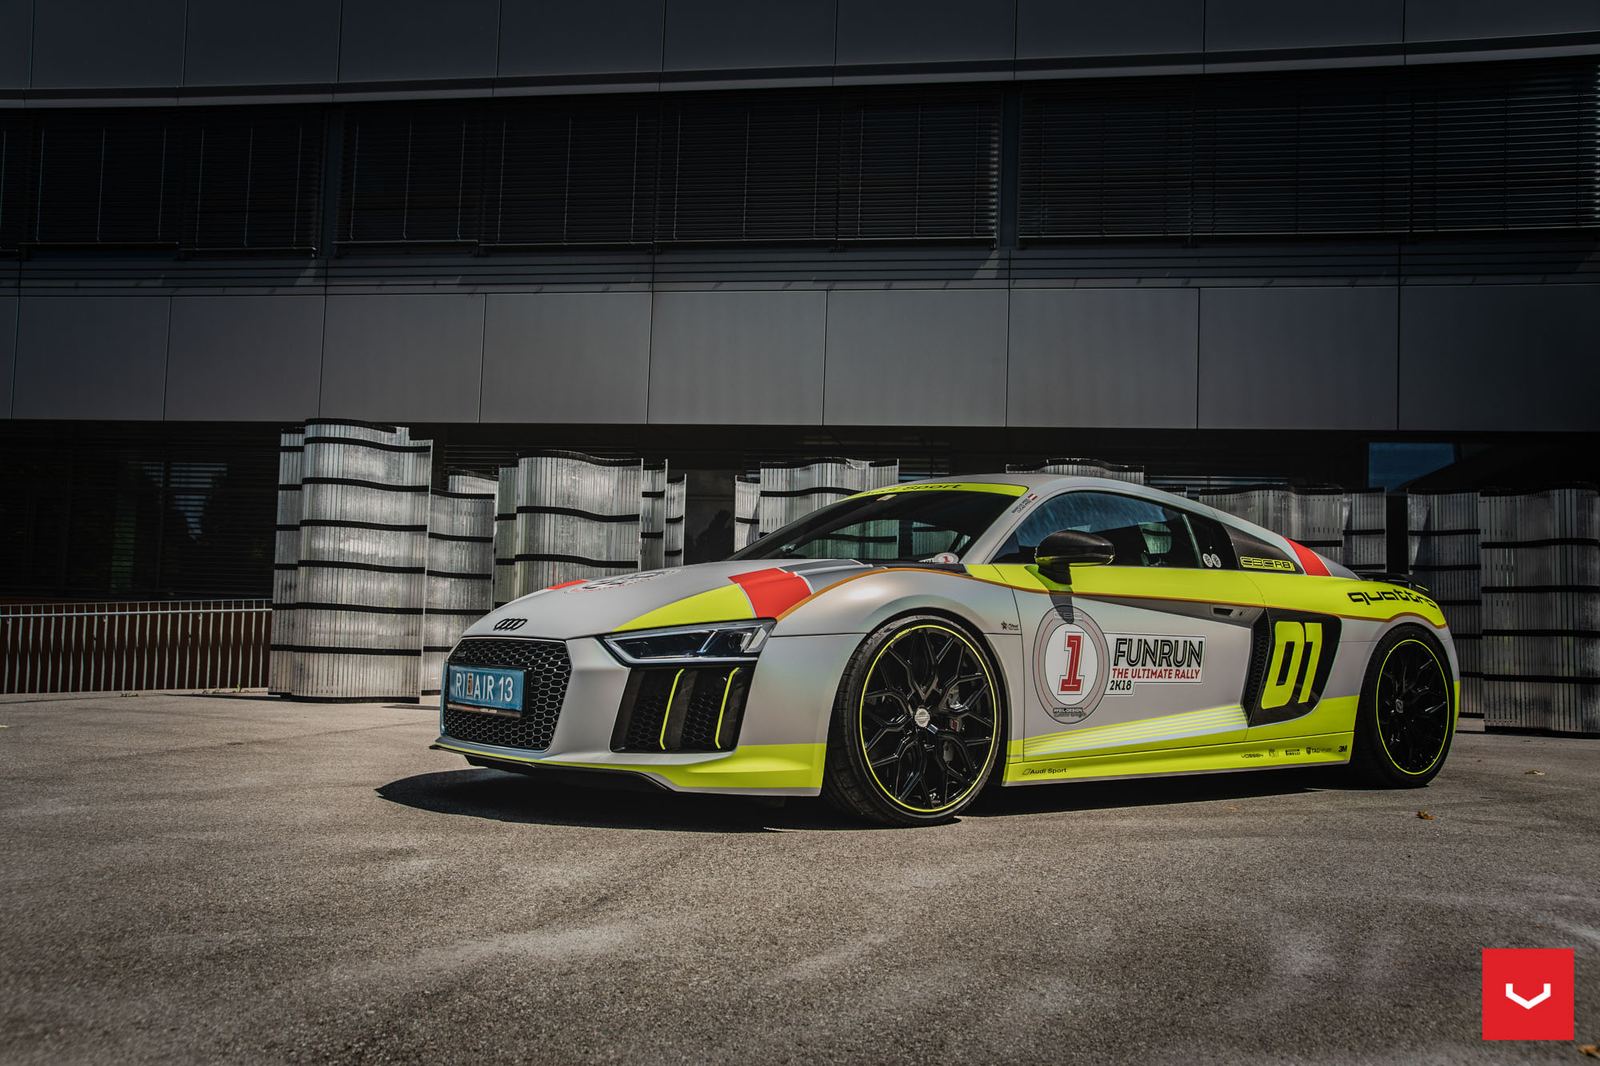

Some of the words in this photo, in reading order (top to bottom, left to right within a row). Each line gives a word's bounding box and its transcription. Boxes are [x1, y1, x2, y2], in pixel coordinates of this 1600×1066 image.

[1347, 588, 1439, 610] quattro
[1058, 632, 1085, 695] 1
[1113, 638, 1203, 668] FUNRUN
[1261, 620, 1323, 710] 01
[1109, 679, 1133, 691] 2K18
[1112, 667, 1129, 679] THE
[1131, 667, 1174, 679] ULTIMATE
[1174, 668, 1201, 680] RALLY
[473, 674, 495, 701] AIR
[498, 675, 514, 702] 13
